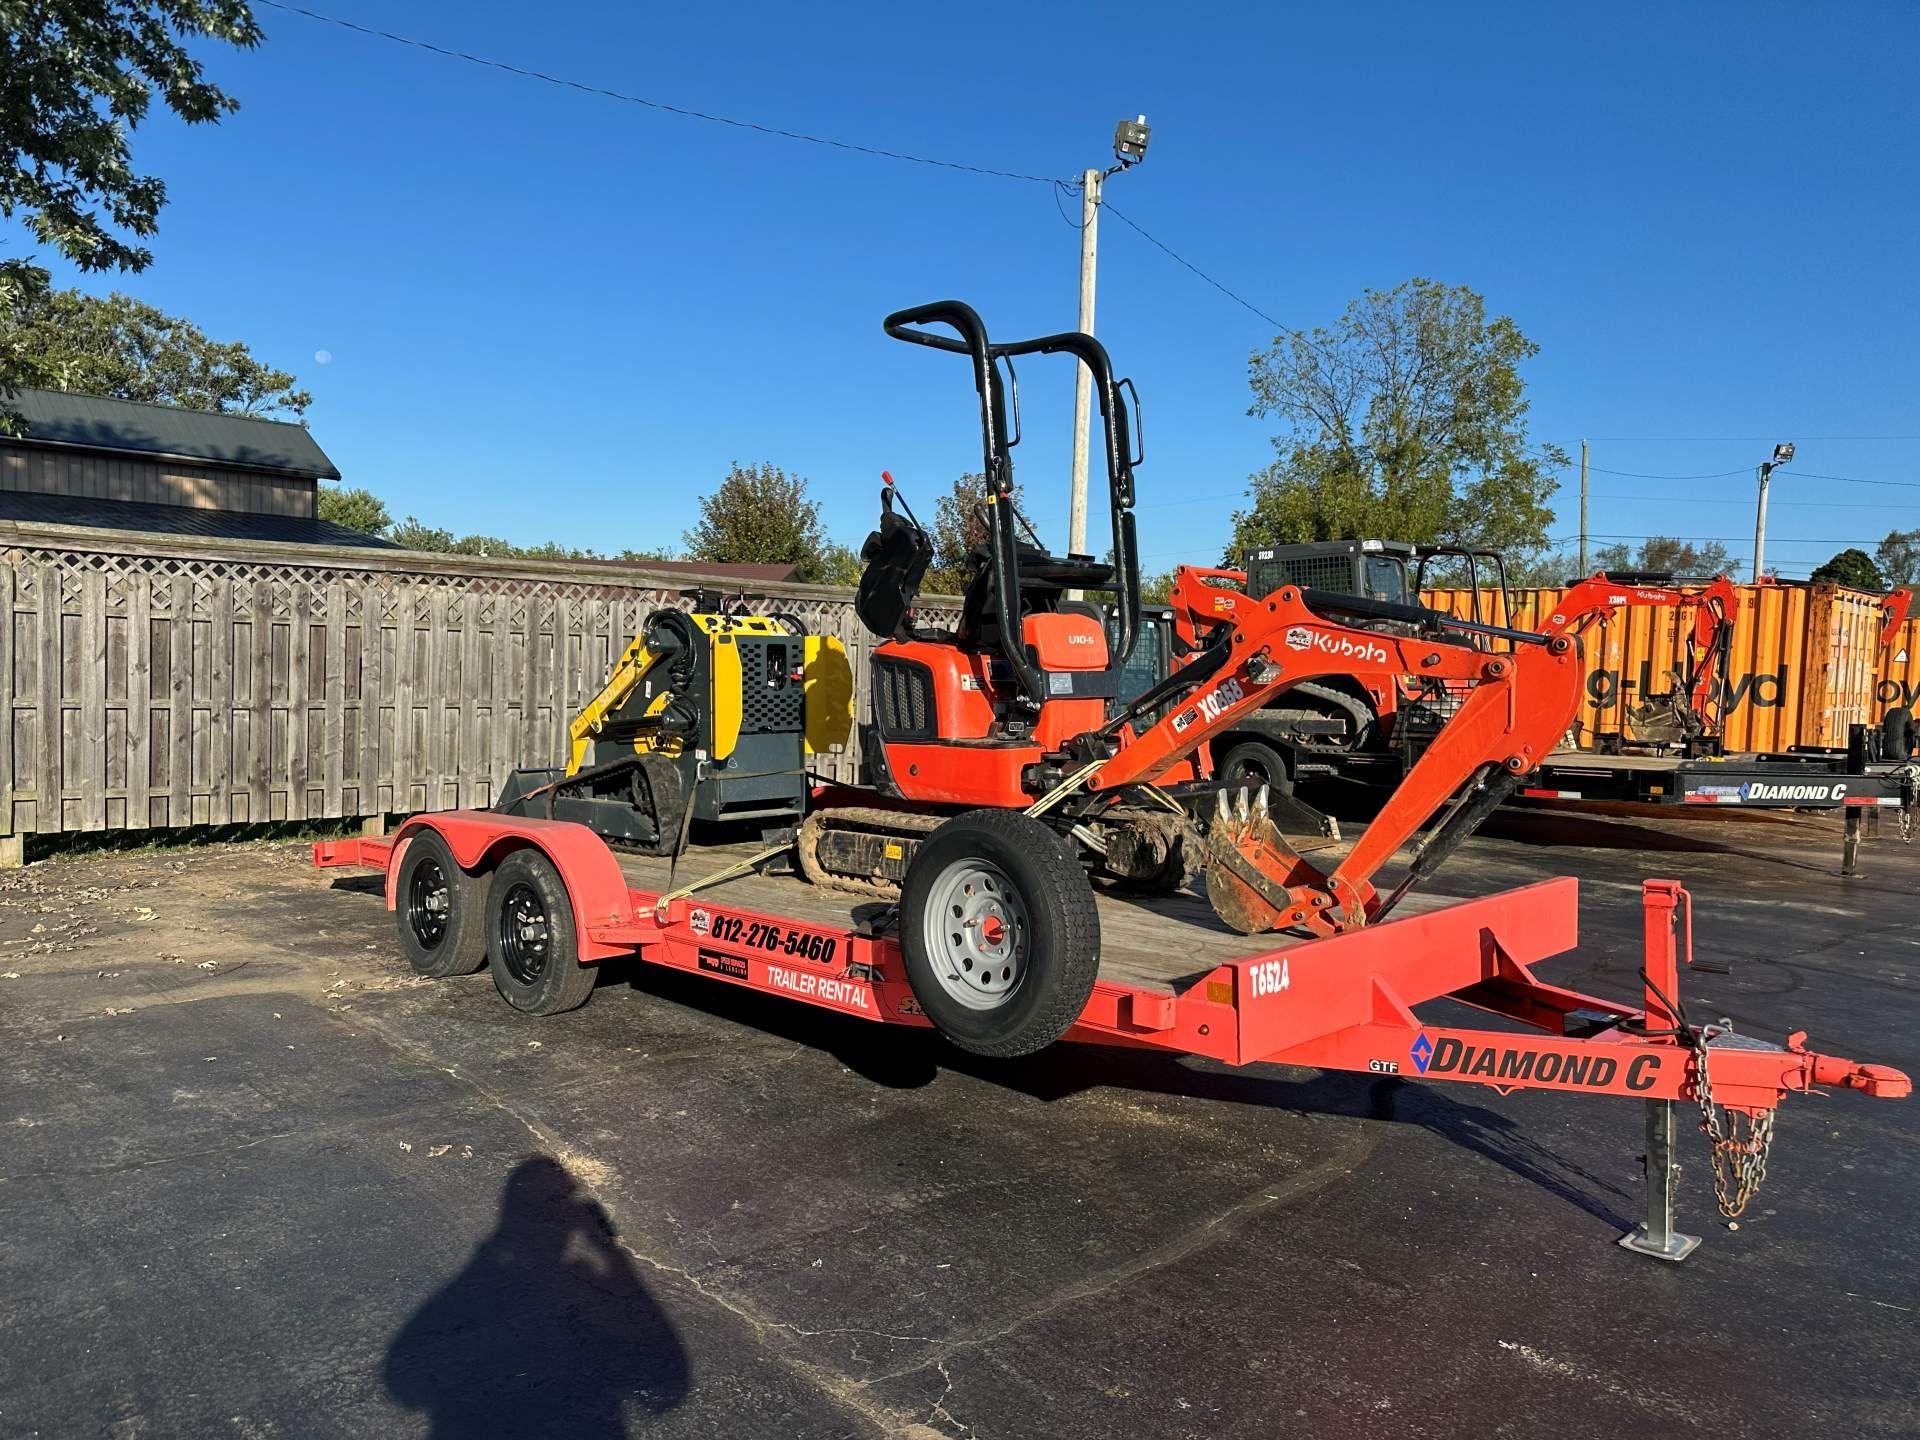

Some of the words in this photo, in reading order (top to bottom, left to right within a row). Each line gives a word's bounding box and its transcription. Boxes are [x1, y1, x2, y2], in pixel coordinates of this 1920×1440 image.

[1313, 632, 1387, 663] Kubota
[1748, 782, 1829, 800] DIAMOND
[1830, 783, 1848, 800] C
[712, 915, 836, 964] 812-276-5460
[767, 966, 817, 995] TRAILER
[818, 978, 869, 1008] RENTAL
[1370, 1060, 1398, 1073] GTF
[1426, 1037, 1616, 1086] DIAMOND
[1625, 1054, 1662, 1091] C
